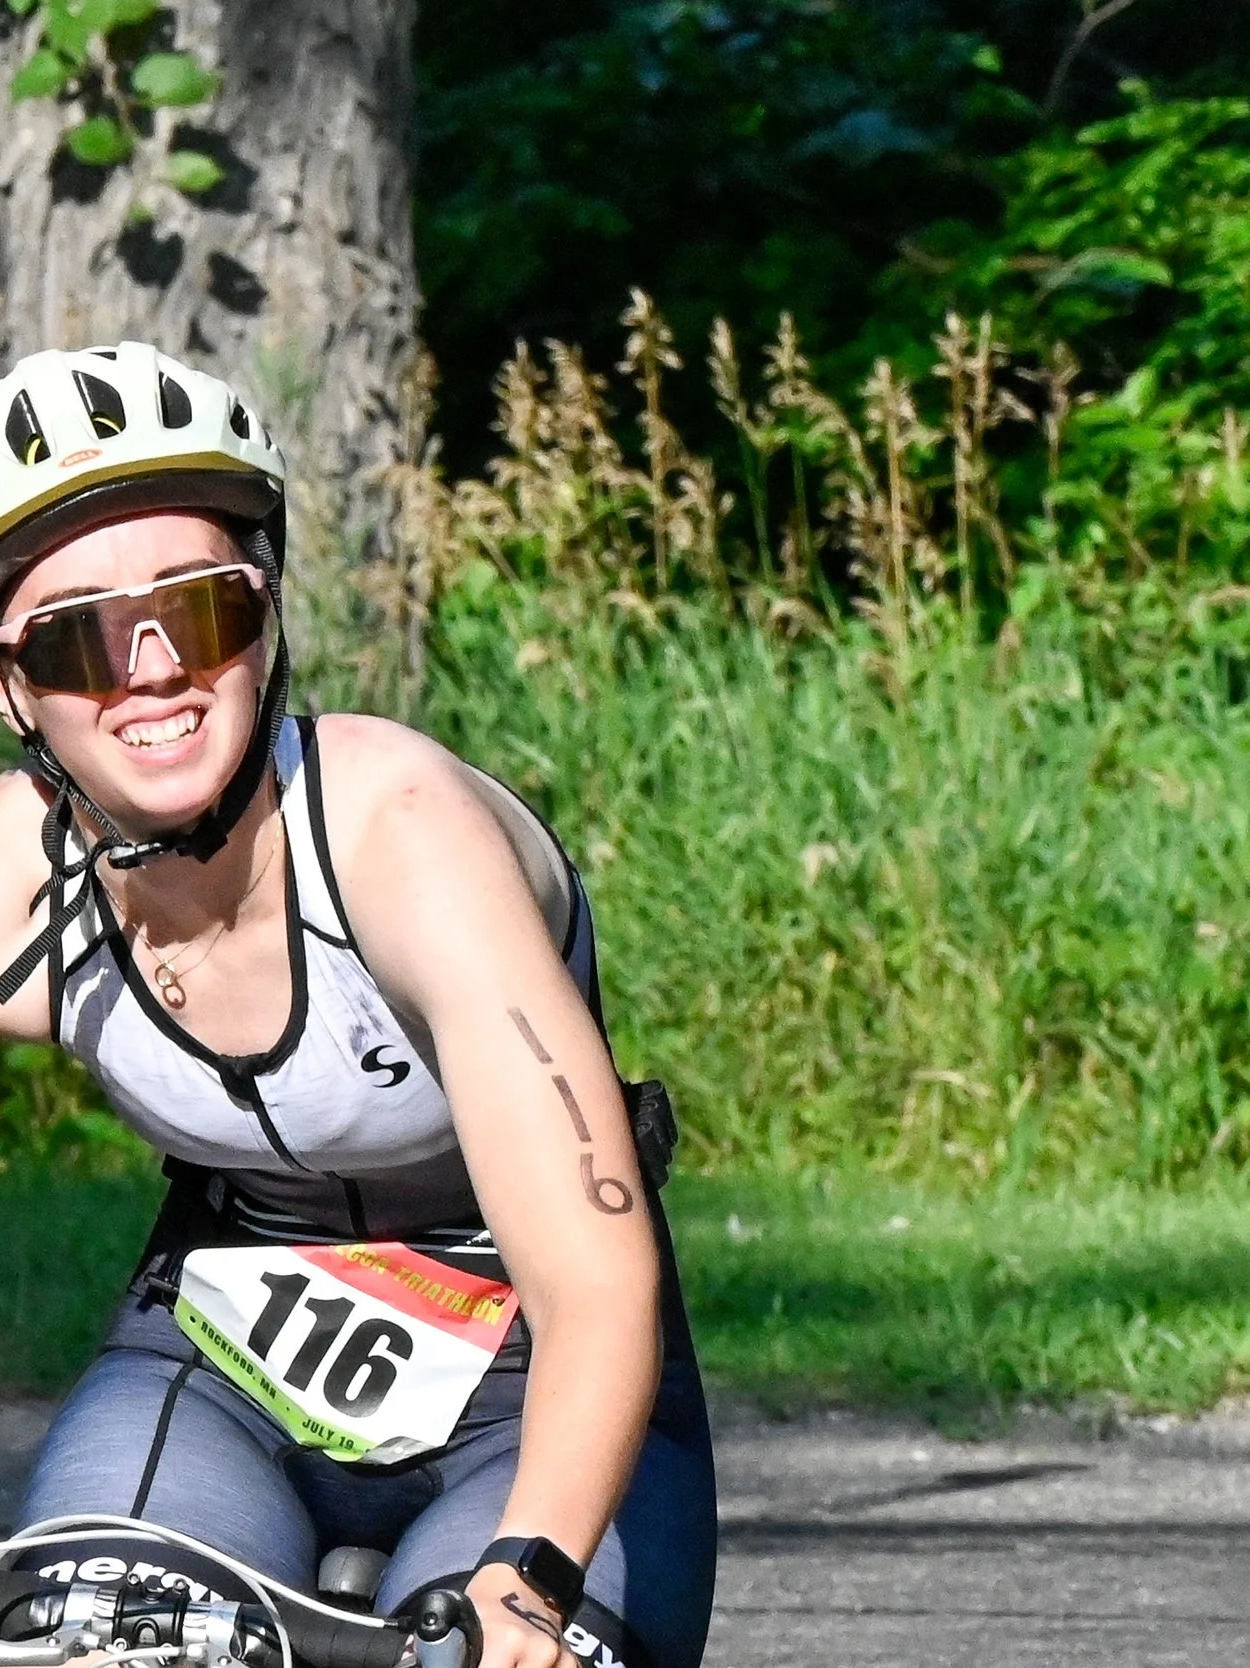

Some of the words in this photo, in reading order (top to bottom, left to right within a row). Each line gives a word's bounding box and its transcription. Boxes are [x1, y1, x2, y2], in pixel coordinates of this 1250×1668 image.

[508, 1007, 633, 1215] 116
[247, 1271, 414, 1419] 116
[393, 1266, 506, 1327] TRIATHLON
[259, 1377, 276, 1399] MN
[302, 1418, 335, 1441] JULY
